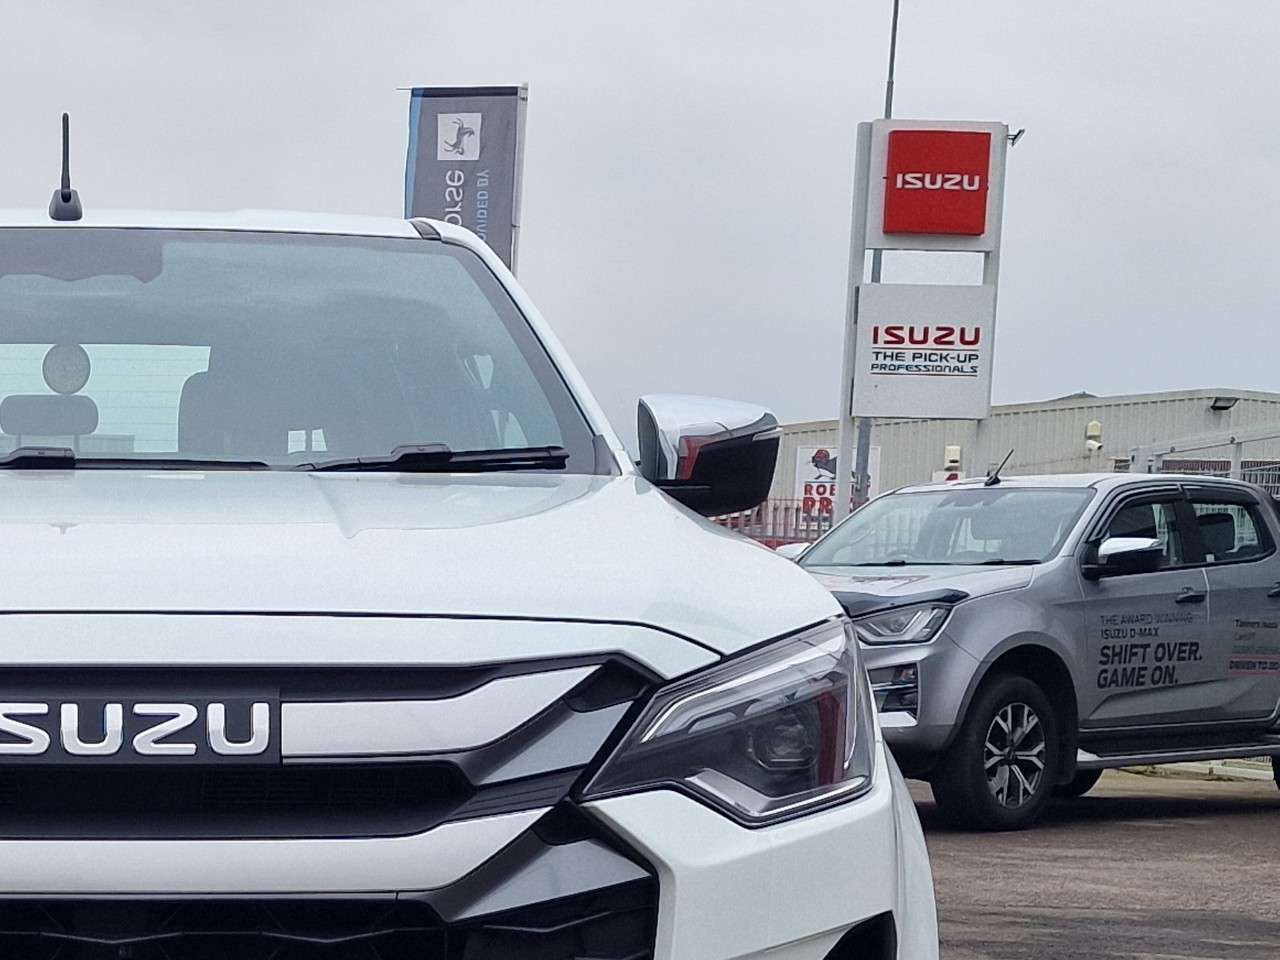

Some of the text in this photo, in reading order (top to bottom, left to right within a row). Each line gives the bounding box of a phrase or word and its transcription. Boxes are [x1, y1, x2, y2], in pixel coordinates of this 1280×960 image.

[895, 172, 980, 191] ISUZU
[872, 325, 981, 346] ISUZU
[872, 351, 979, 364] THE PICK-UP
[870, 362, 978, 374] PROFESSIONALS
[1100, 614, 1119, 626] THE
[1100, 628, 1128, 640] ISUZU
[1099, 641, 1203, 666] SHIFT OVER.
[1097, 665, 1179, 690] GAME ON.
